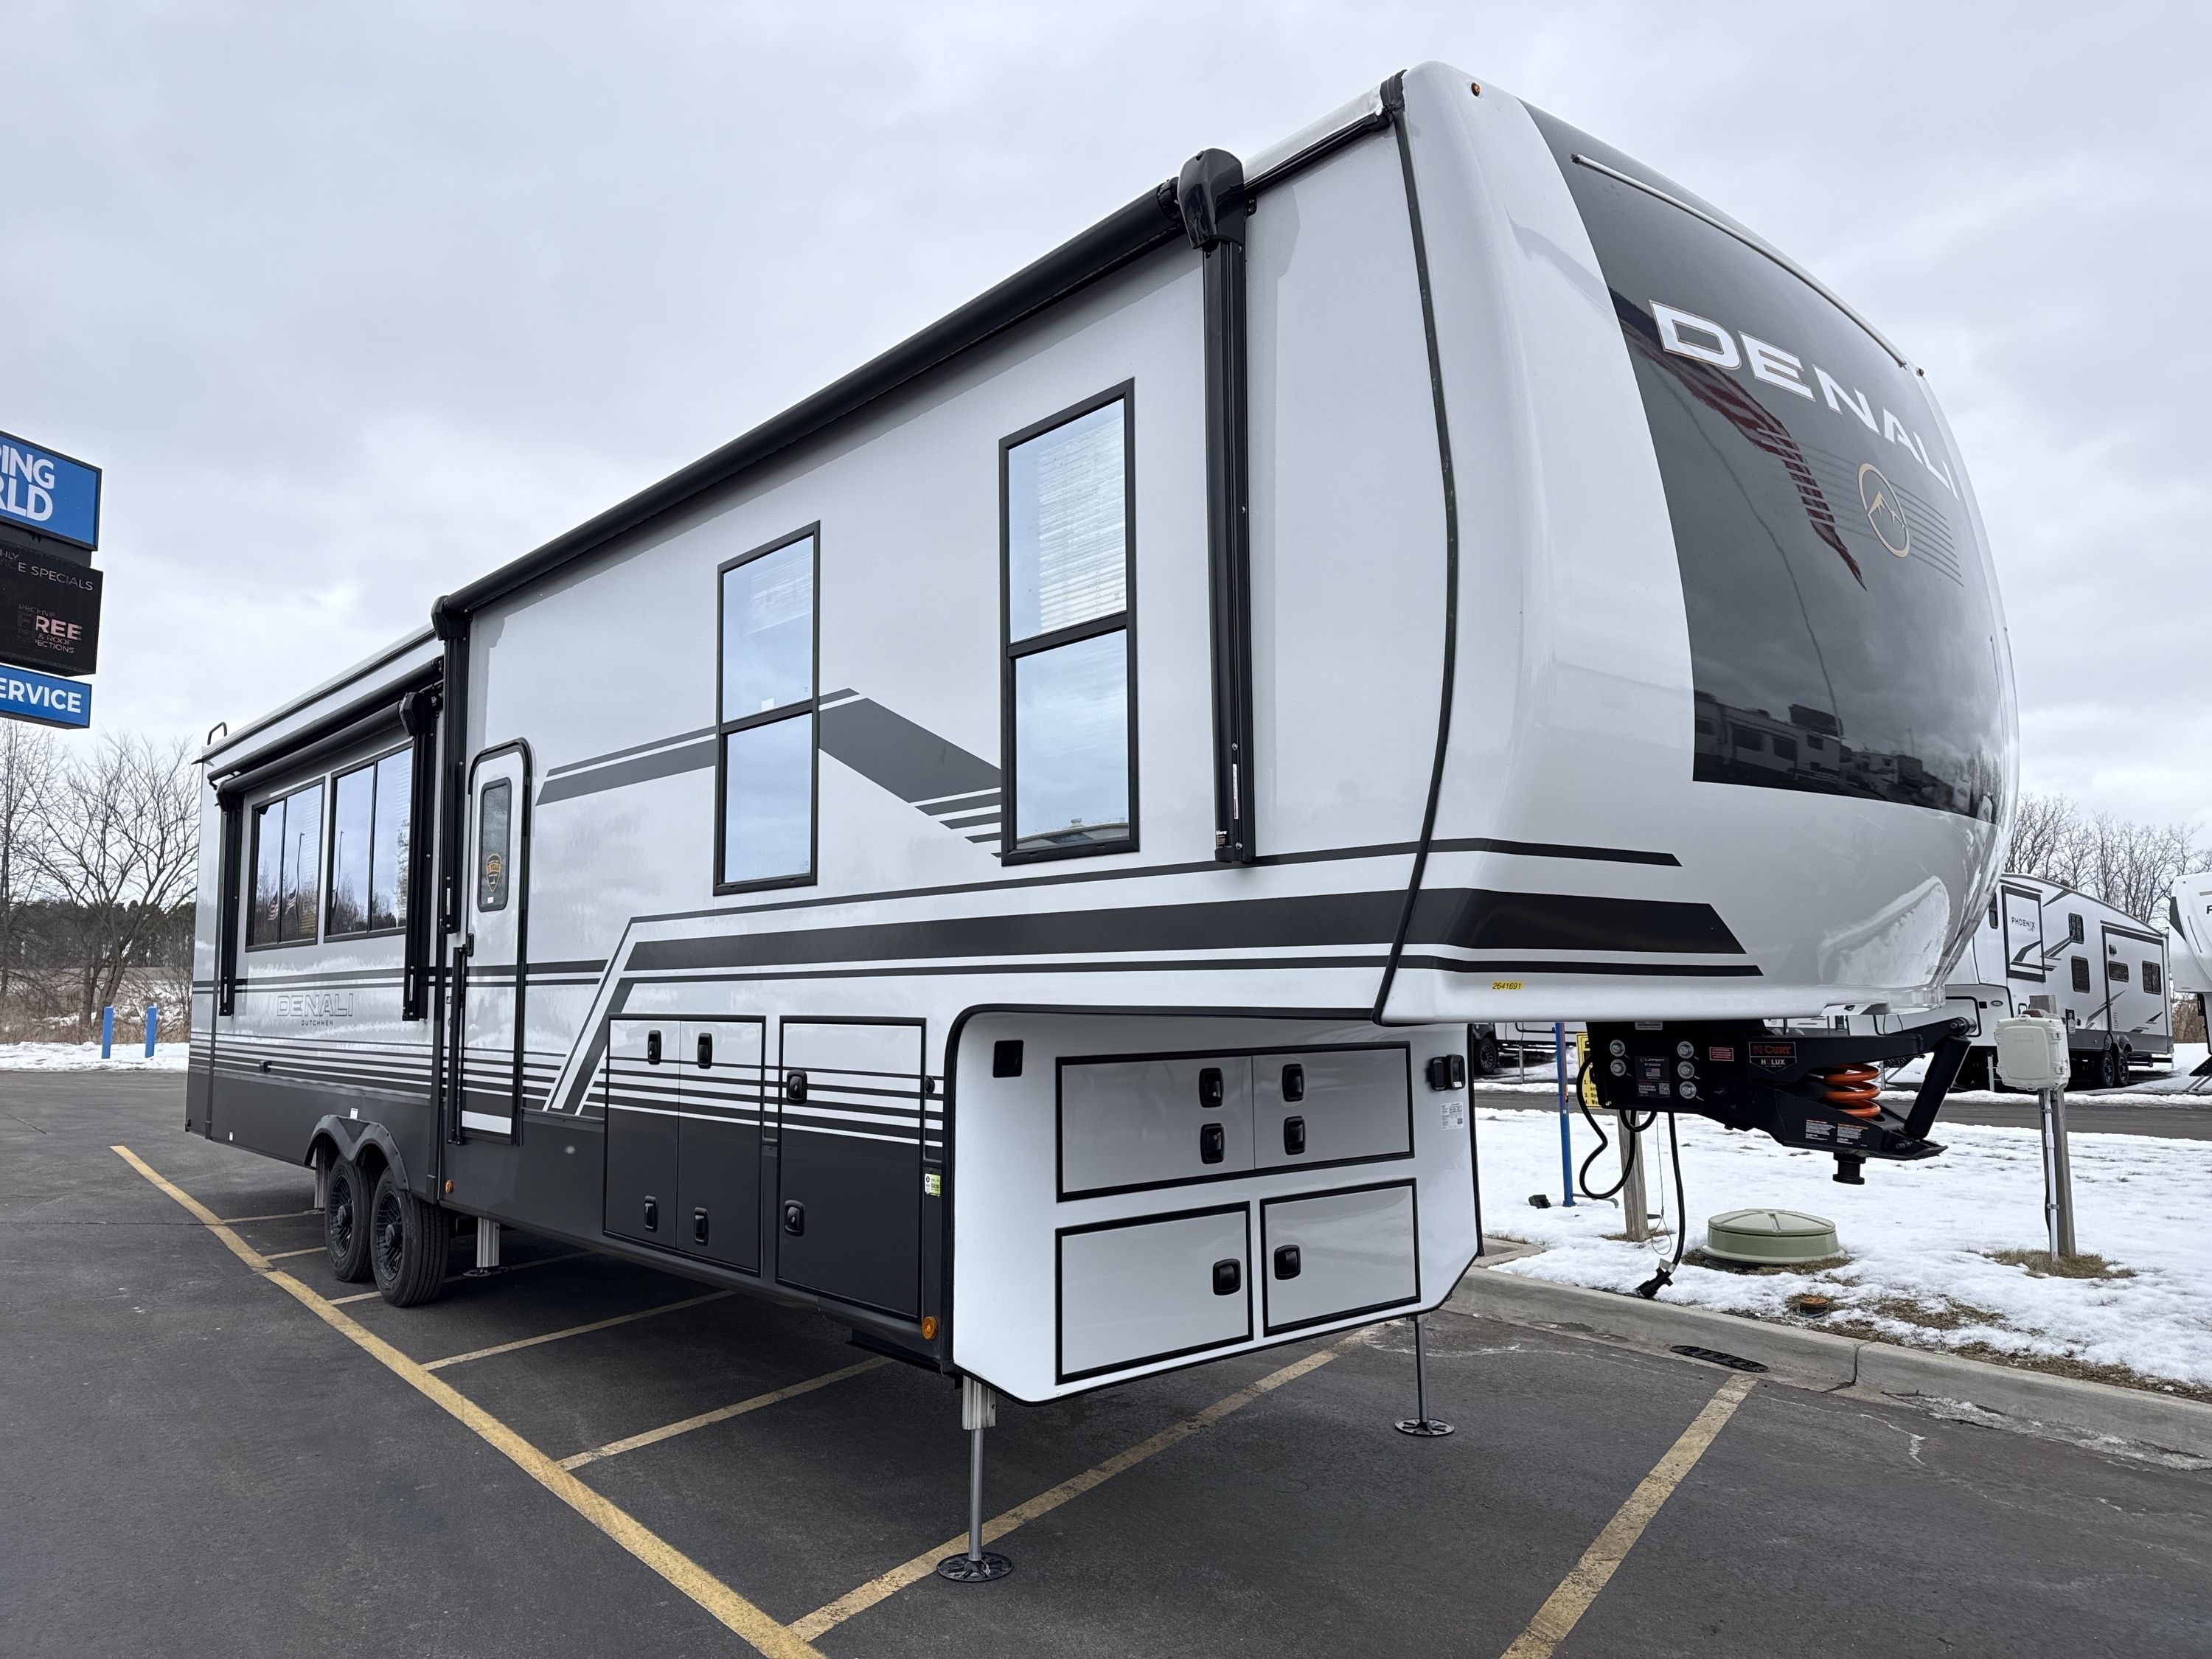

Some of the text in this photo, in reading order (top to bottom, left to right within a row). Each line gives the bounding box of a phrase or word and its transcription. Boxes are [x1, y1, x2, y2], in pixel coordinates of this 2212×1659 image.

[1649, 299, 1960, 501] DENALI
[0, 444, 55, 490] ING
[30, 566, 94, 591] SPECIALS
[2011, 917, 2035, 928] PHOENIX
[276, 992, 354, 1017] DENALI
